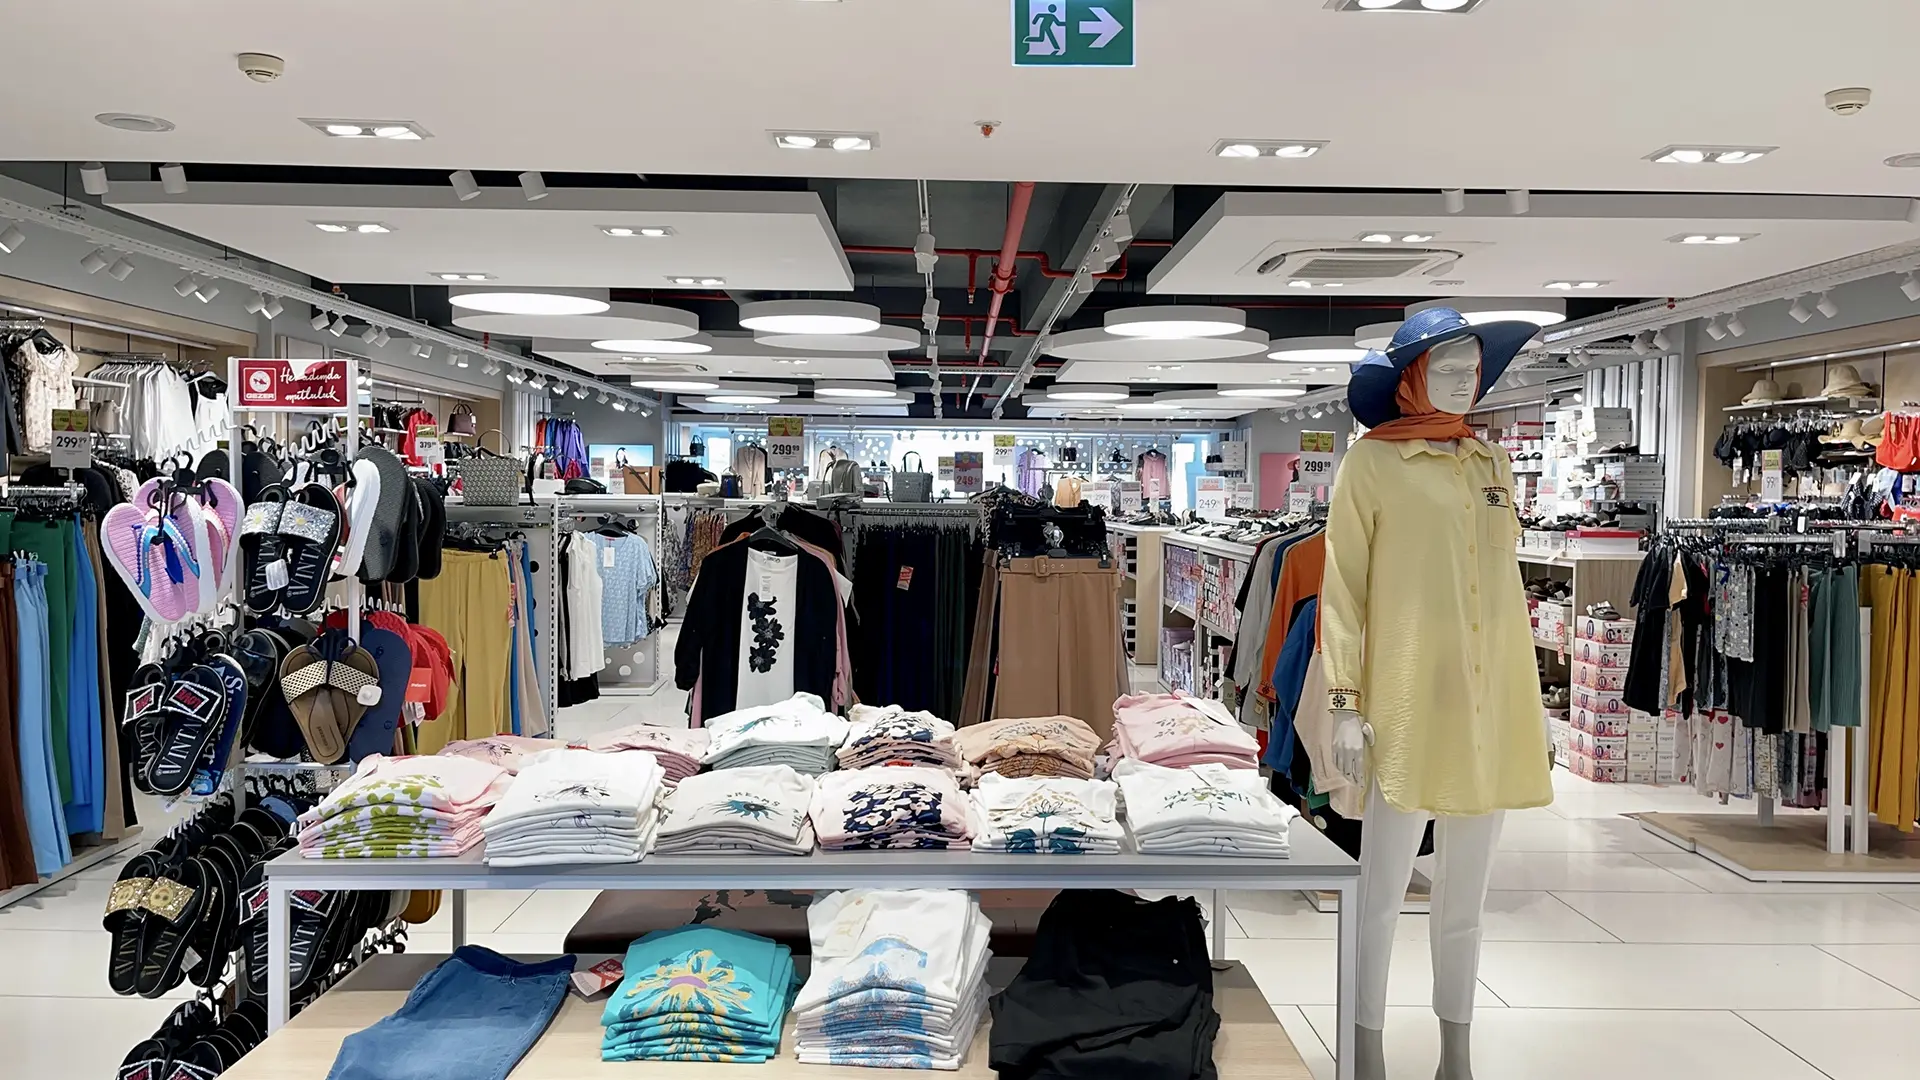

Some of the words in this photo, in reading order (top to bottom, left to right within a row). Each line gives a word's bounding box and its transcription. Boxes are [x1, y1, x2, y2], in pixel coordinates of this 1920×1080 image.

[285, 385, 341, 404] mutluluk
[56, 436, 78, 448] 299
[772, 444, 792, 455] 299
[995, 448, 1008, 456] 299
[1304, 460, 1323, 472] 299
[956, 475, 973, 486] 249
[1198, 498, 1217, 509] 249
